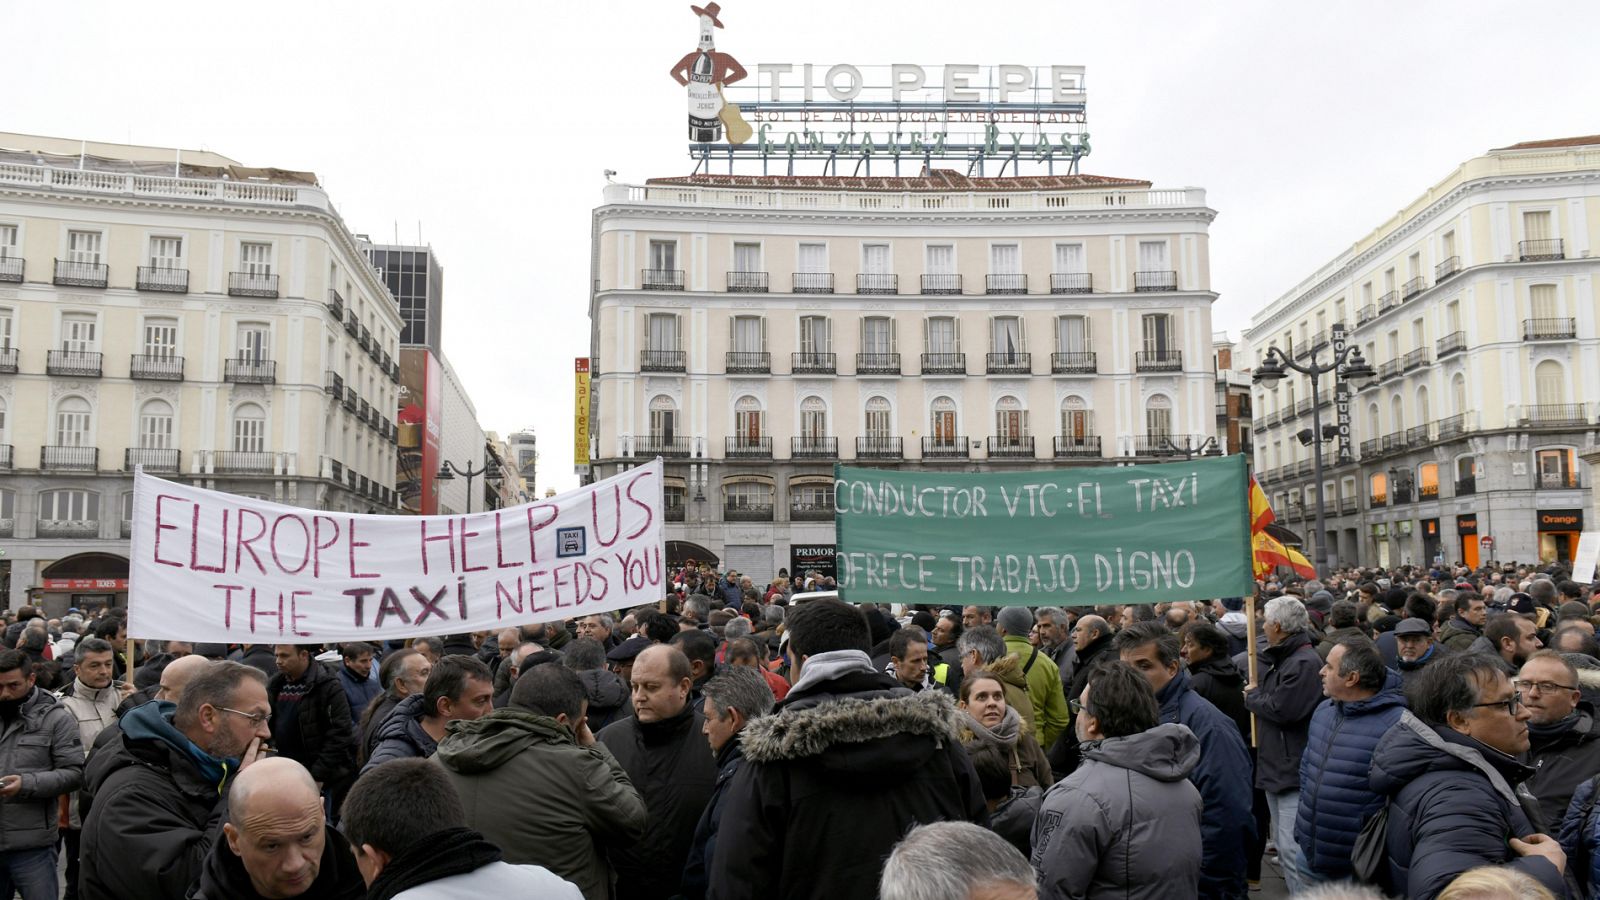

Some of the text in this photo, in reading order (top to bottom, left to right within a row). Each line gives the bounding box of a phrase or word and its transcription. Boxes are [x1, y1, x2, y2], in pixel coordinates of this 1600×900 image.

[758, 63, 1087, 103] TIO PEPE
[754, 111, 1087, 123] SOL DE ANDALUCIA EMBOTELLADO
[760, 123, 1092, 156] GONZALEZ BYASS
[578, 375, 586, 436] Lartec
[1338, 392, 1350, 457] EUROPA
[834, 479, 988, 518] CONDUCTOR
[154, 471, 653, 578] EUROPE HELP US
[1542, 514, 1578, 524] Orange
[796, 548, 834, 556] PRIMOR
[213, 584, 313, 637] THE
[496, 557, 608, 620] NEEDS
[616, 544, 661, 595] YOU
[836, 552, 937, 592] OFRECE
[950, 553, 1080, 594] TRABAJO
